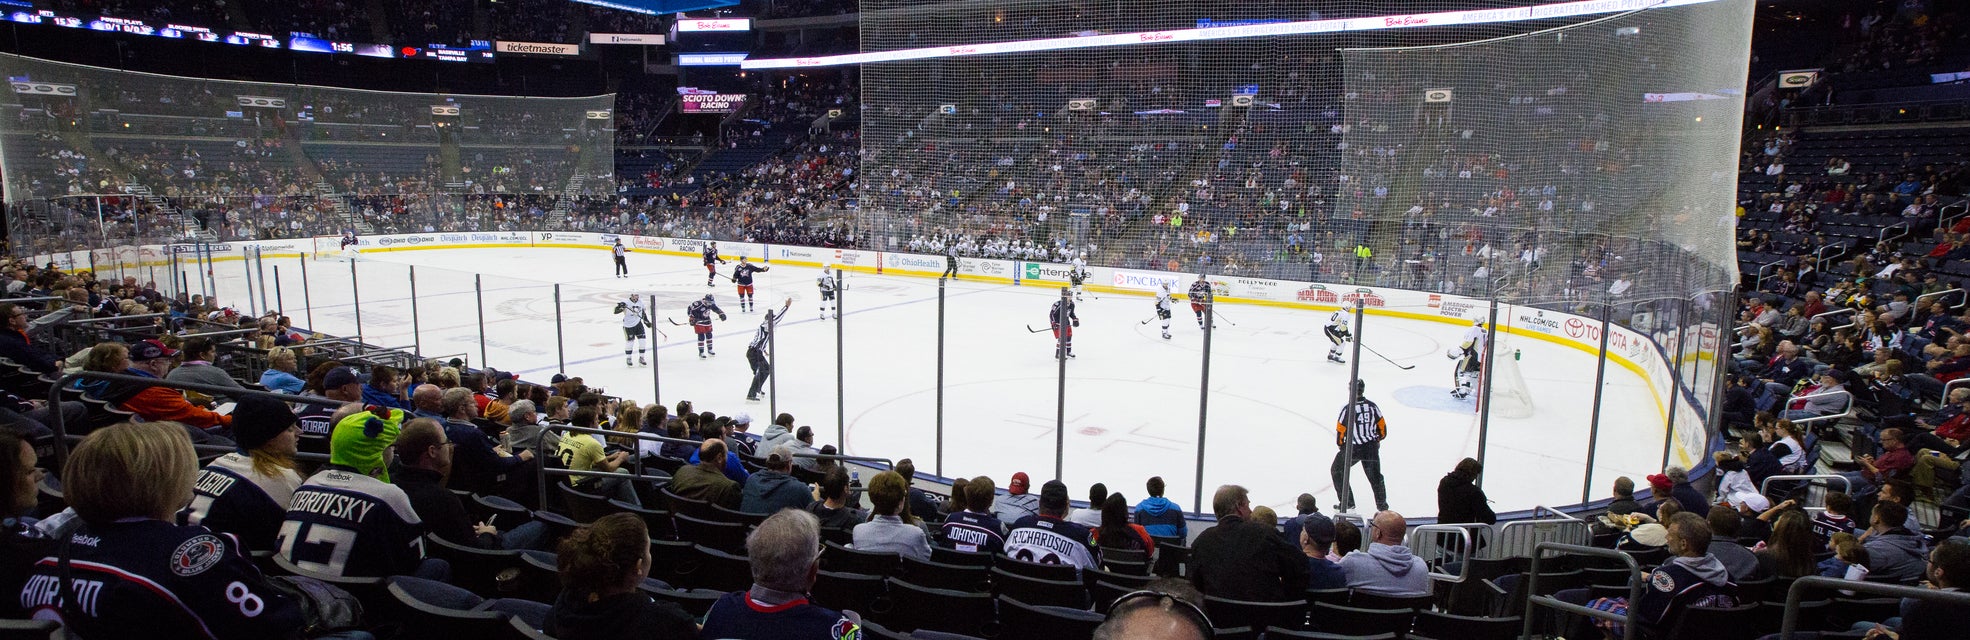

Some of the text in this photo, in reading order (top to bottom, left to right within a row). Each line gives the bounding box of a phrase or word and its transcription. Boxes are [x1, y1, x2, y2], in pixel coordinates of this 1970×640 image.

[1462, 11, 1504, 21] AMERICA'S
[1507, 10, 1516, 19] #1
[1519, 4, 1579, 18] RERIGERATED
[1582, 1, 1618, 12] MASHED
[1385, 16, 1429, 27] Bob Evans
[331, 42, 353, 52] 1:56
[507, 43, 566, 54] ticketmaster
[683, 94, 747, 102] SCIOTO DOWNS
[471, 233, 498, 242] Dispatch
[541, 232, 552, 240] yp
[901, 258, 940, 268] OhioHealth
[1126, 275, 1179, 288] PNC BAK
[1442, 301, 1474, 309] AMERICAN
[1440, 310, 1462, 318] POWER
[1519, 315, 1559, 329] NHL.COM/GCL
[1357, 412, 1370, 424] 49
[301, 420, 330, 434] BOBRO
[287, 490, 376, 523] OBROVSKY
[947, 526, 988, 546] JOHNSON
[1012, 531, 1074, 557] RICHARDSON
[20, 574, 104, 618] HORON
[225, 581, 264, 618] 8
